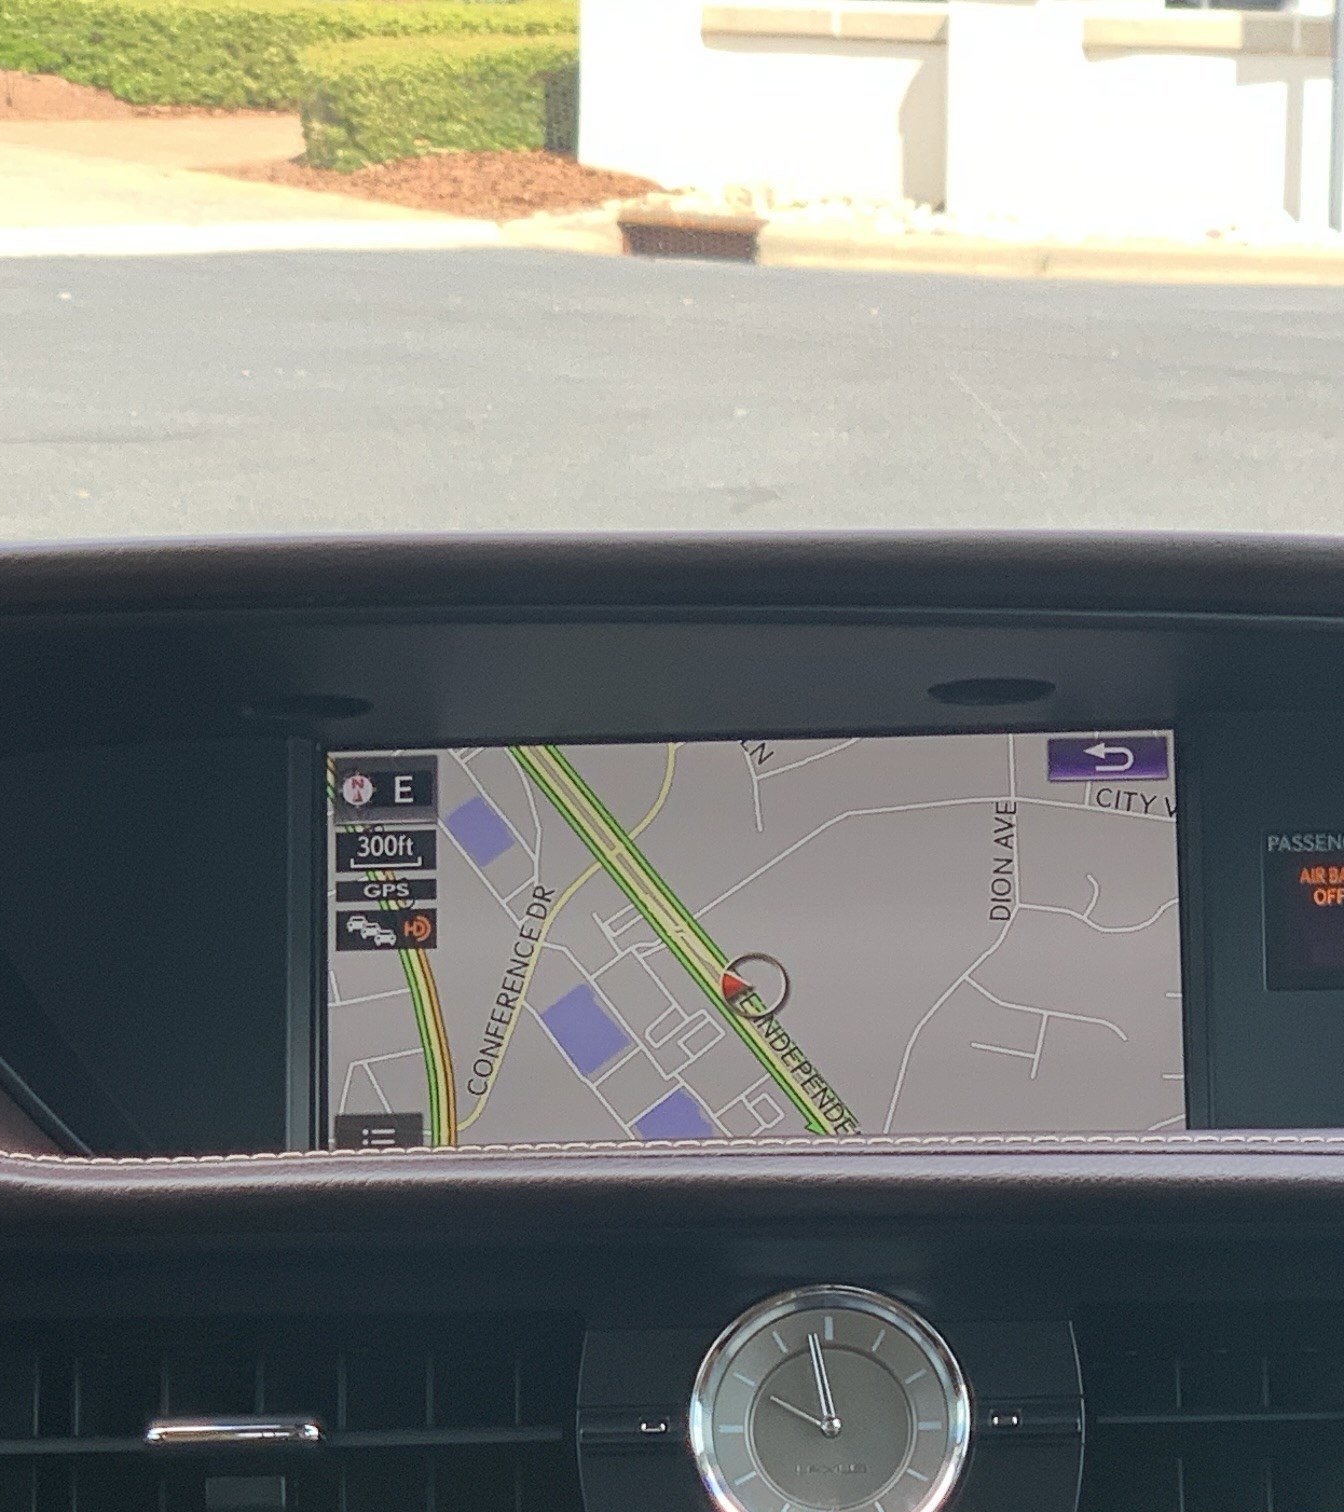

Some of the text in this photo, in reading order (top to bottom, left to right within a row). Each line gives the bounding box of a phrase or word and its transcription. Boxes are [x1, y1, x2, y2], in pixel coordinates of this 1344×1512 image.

[394, 775, 414, 804] E
[1096, 787, 1156, 814] CITY
[357, 834, 414, 857] 300ft
[989, 801, 1017, 921] DION AVE
[1299, 866, 1326, 884] AIR
[363, 883, 410, 898] GPS
[467, 885, 556, 1096] CONFERENCE DR
